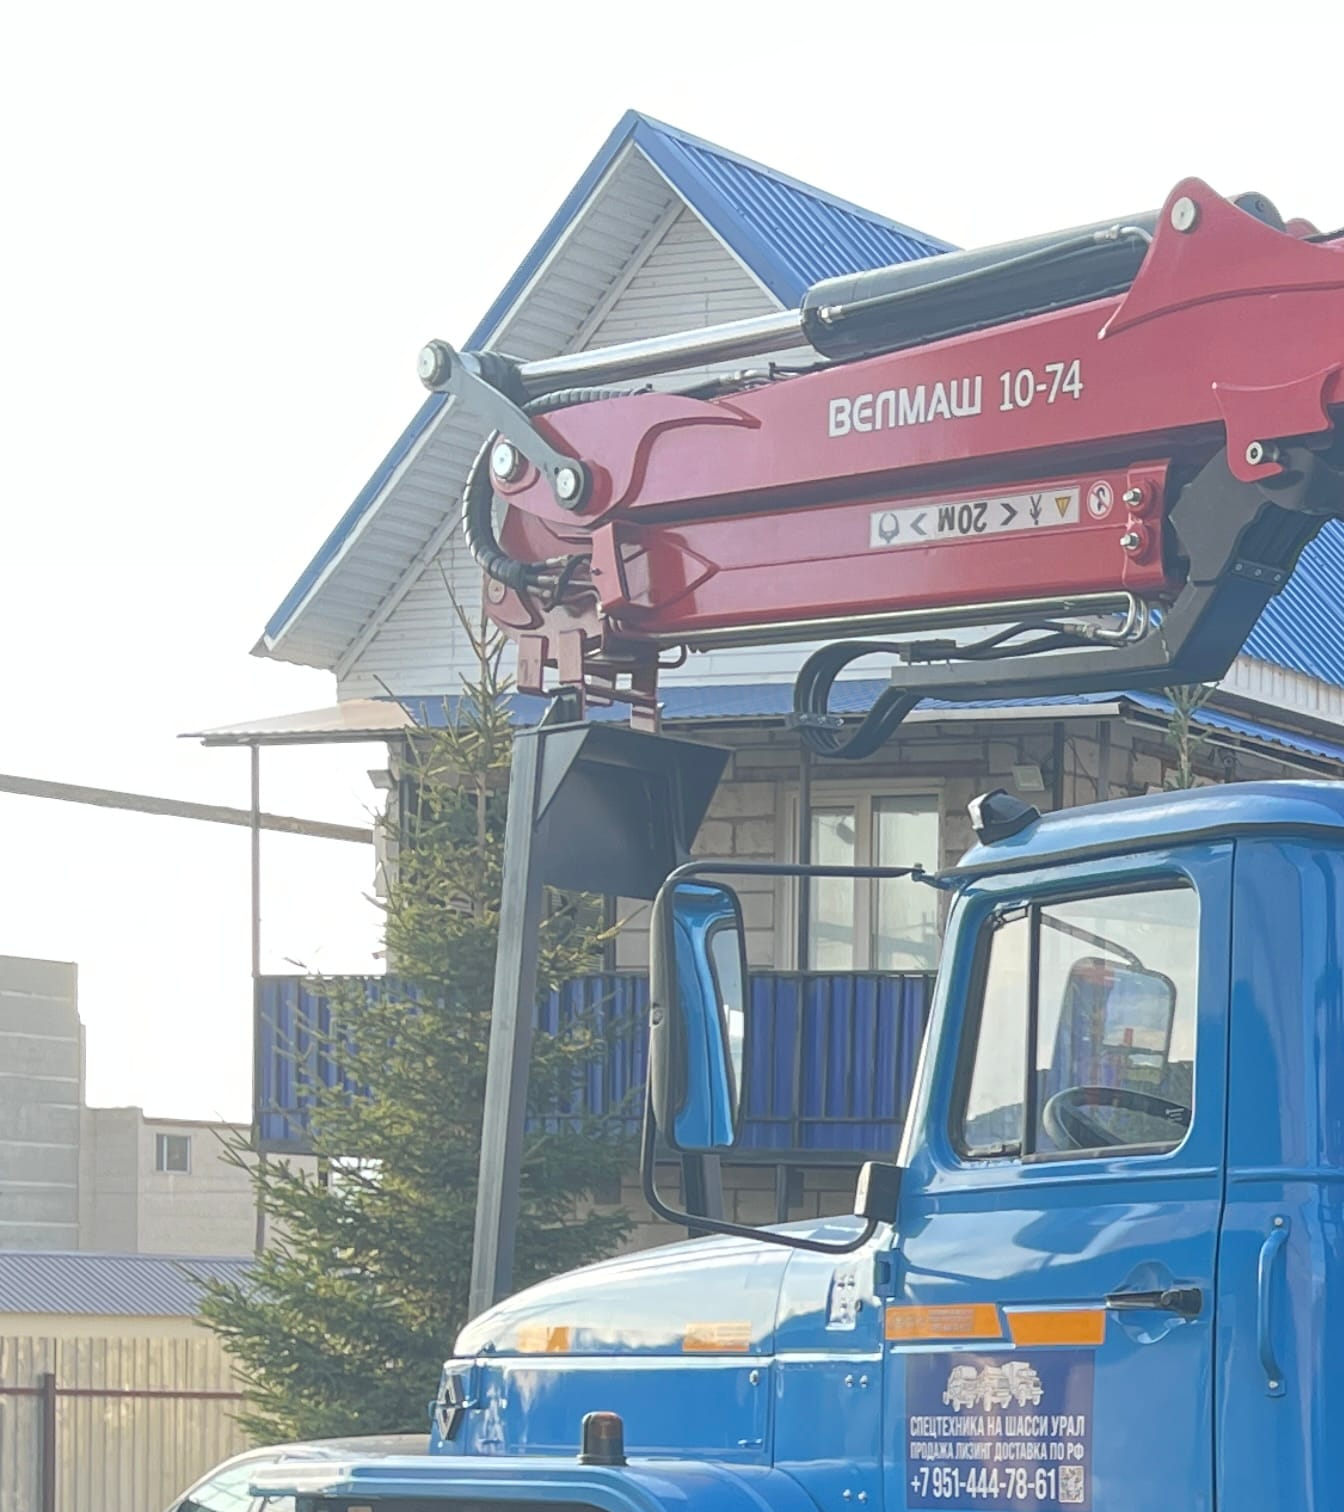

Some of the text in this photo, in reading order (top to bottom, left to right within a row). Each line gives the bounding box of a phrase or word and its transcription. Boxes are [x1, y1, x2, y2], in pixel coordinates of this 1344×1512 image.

[828, 359, 1084, 438] ВЕЛМАШ 10-74
[910, 1415, 1085, 1439] СПЕЦТЕХНИКА НА ШАССИ УРАЛ
[910, 1443, 954, 1461] ПРОДАЖА
[994, 1442, 1047, 1462] ДОСТАВКА
[1050, 1442, 1065, 1460] ПО
[1066, 1443, 1084, 1461] РФ
[911, 1467, 1056, 1500] +7 951-444-78-61
